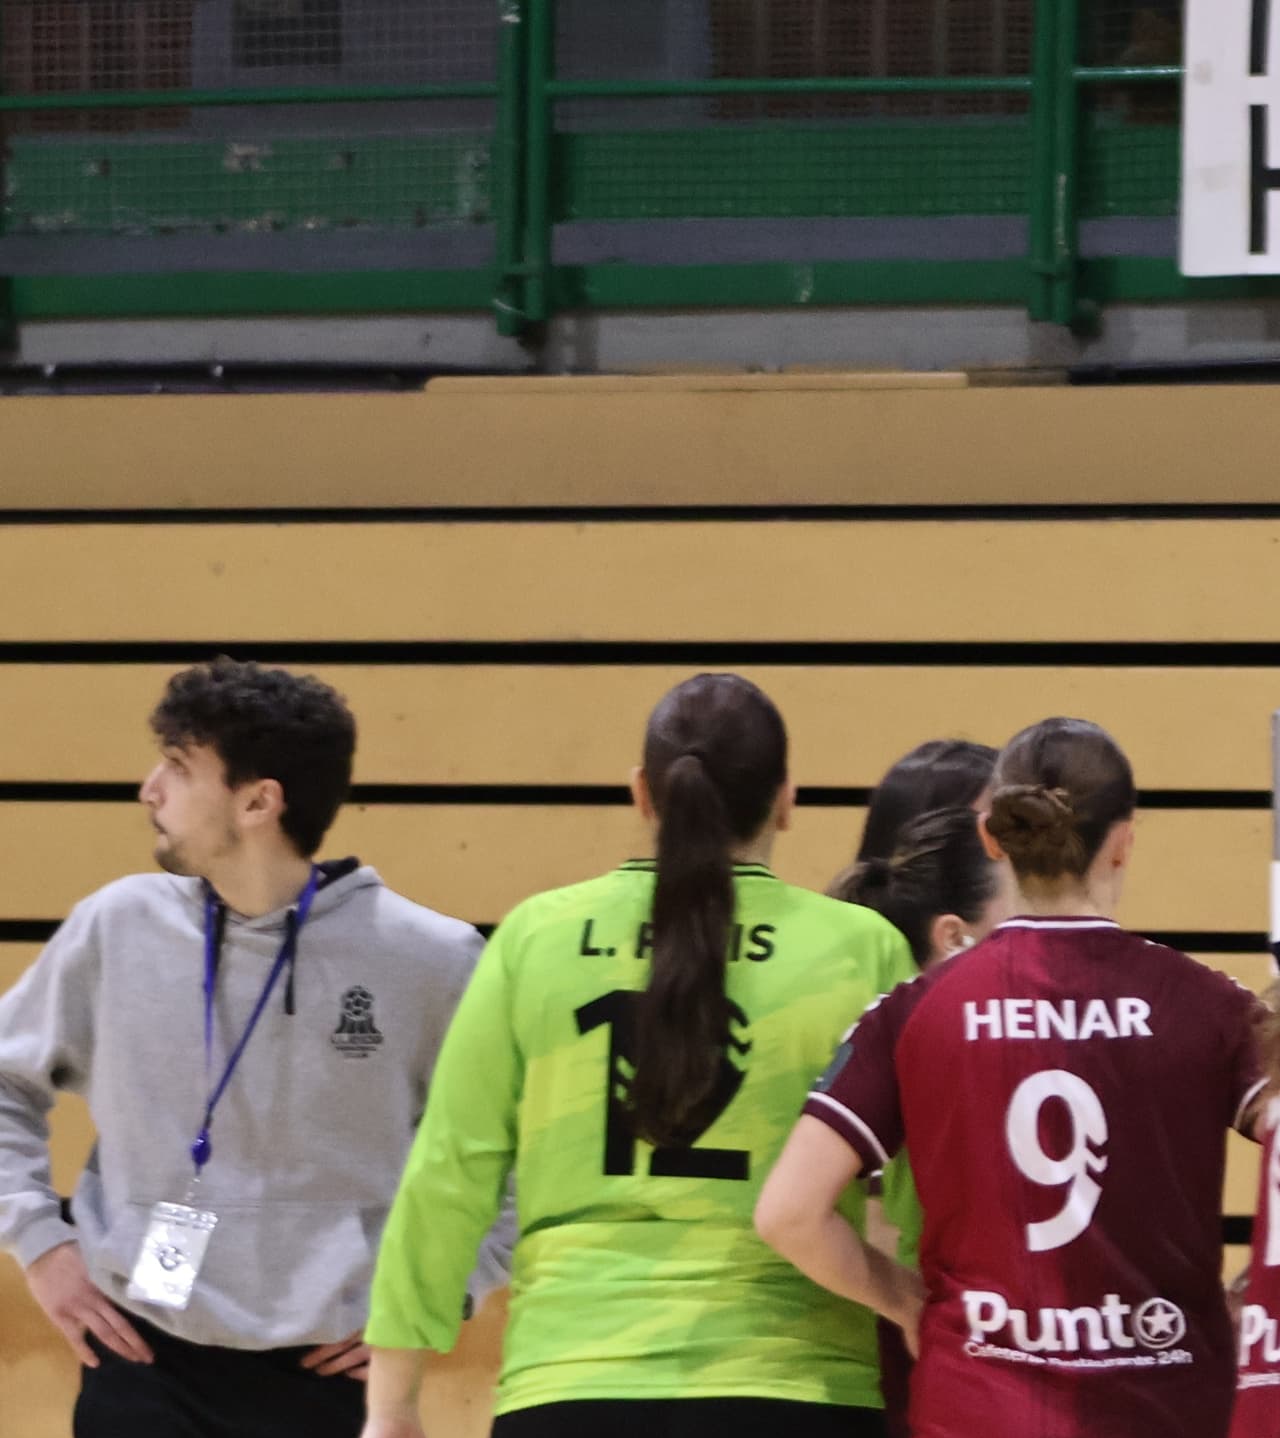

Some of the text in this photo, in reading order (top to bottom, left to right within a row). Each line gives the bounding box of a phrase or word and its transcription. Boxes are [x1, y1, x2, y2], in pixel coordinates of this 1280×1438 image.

[579, 918, 617, 957] L.
[963, 997, 1153, 1041] HENAR
[1005, 1068, 1110, 1253] 9
